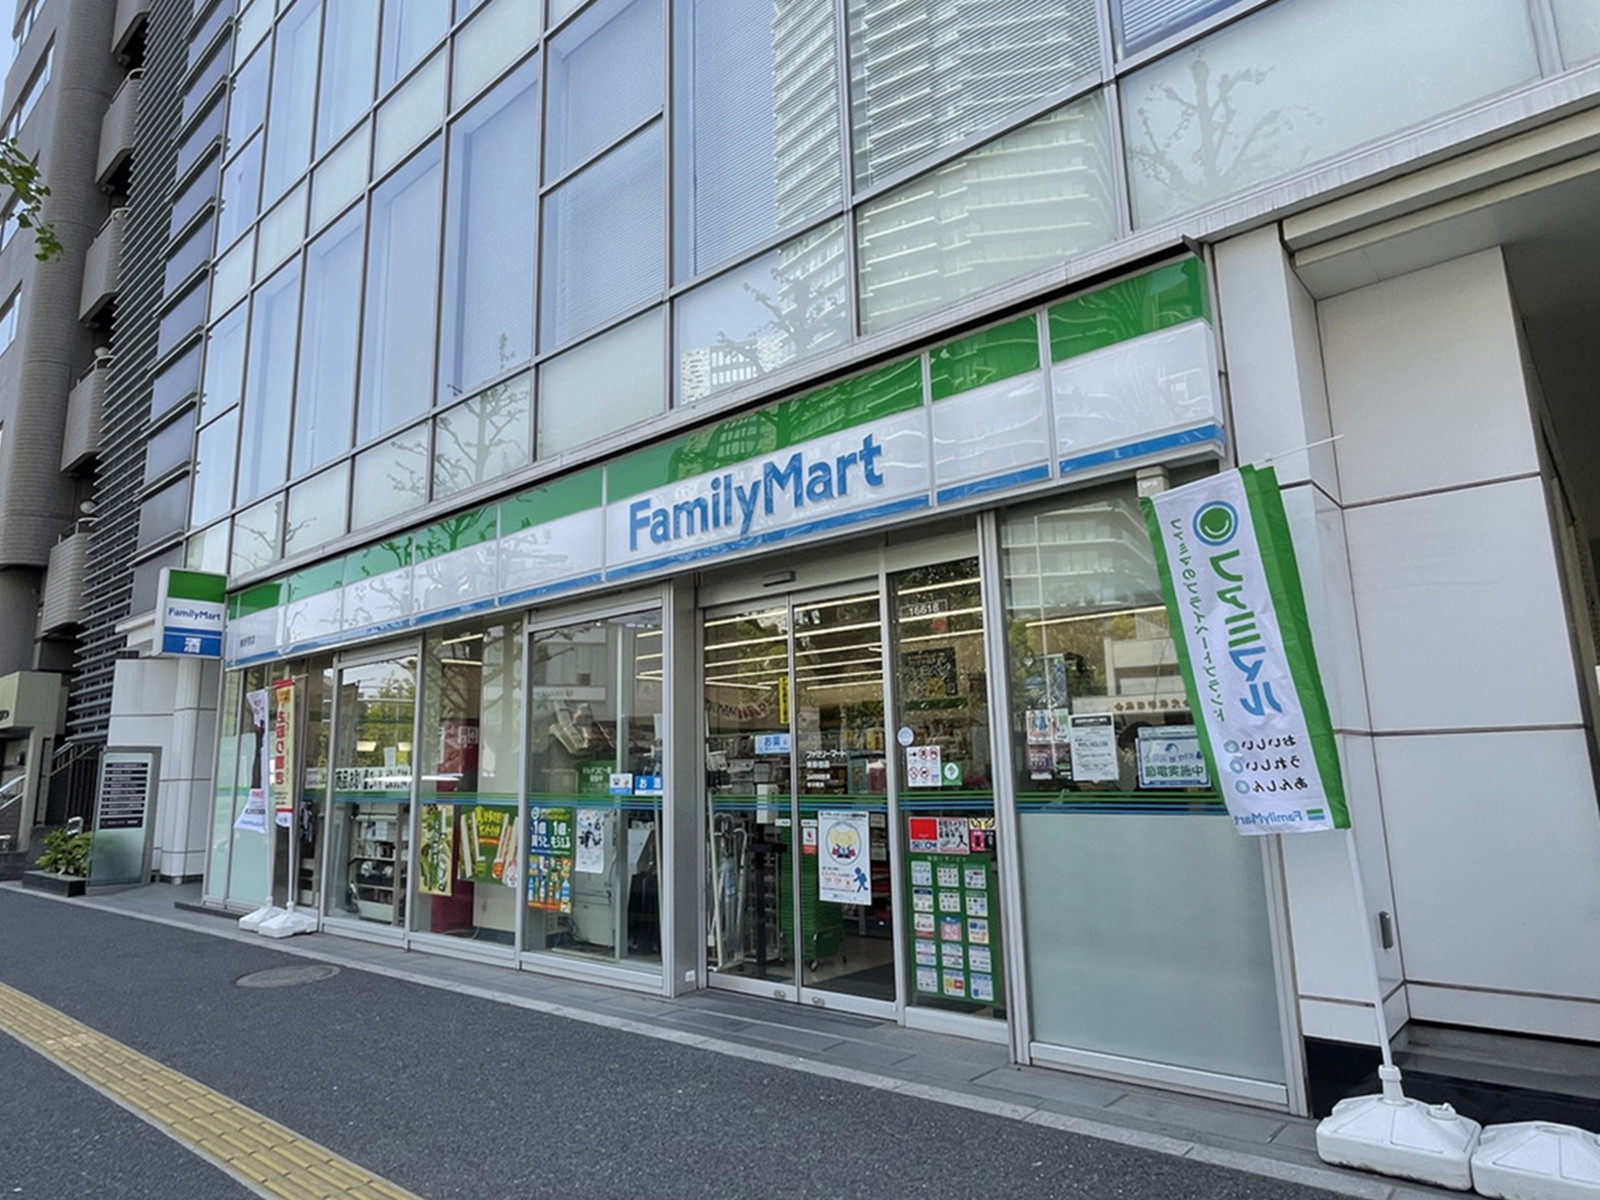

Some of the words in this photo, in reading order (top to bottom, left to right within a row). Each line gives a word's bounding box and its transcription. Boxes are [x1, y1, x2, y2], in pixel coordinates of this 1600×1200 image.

[629, 434, 884, 551] FamilyMart
[168, 607, 221, 621] FamilyMart
[184, 637, 201, 653] 酒
